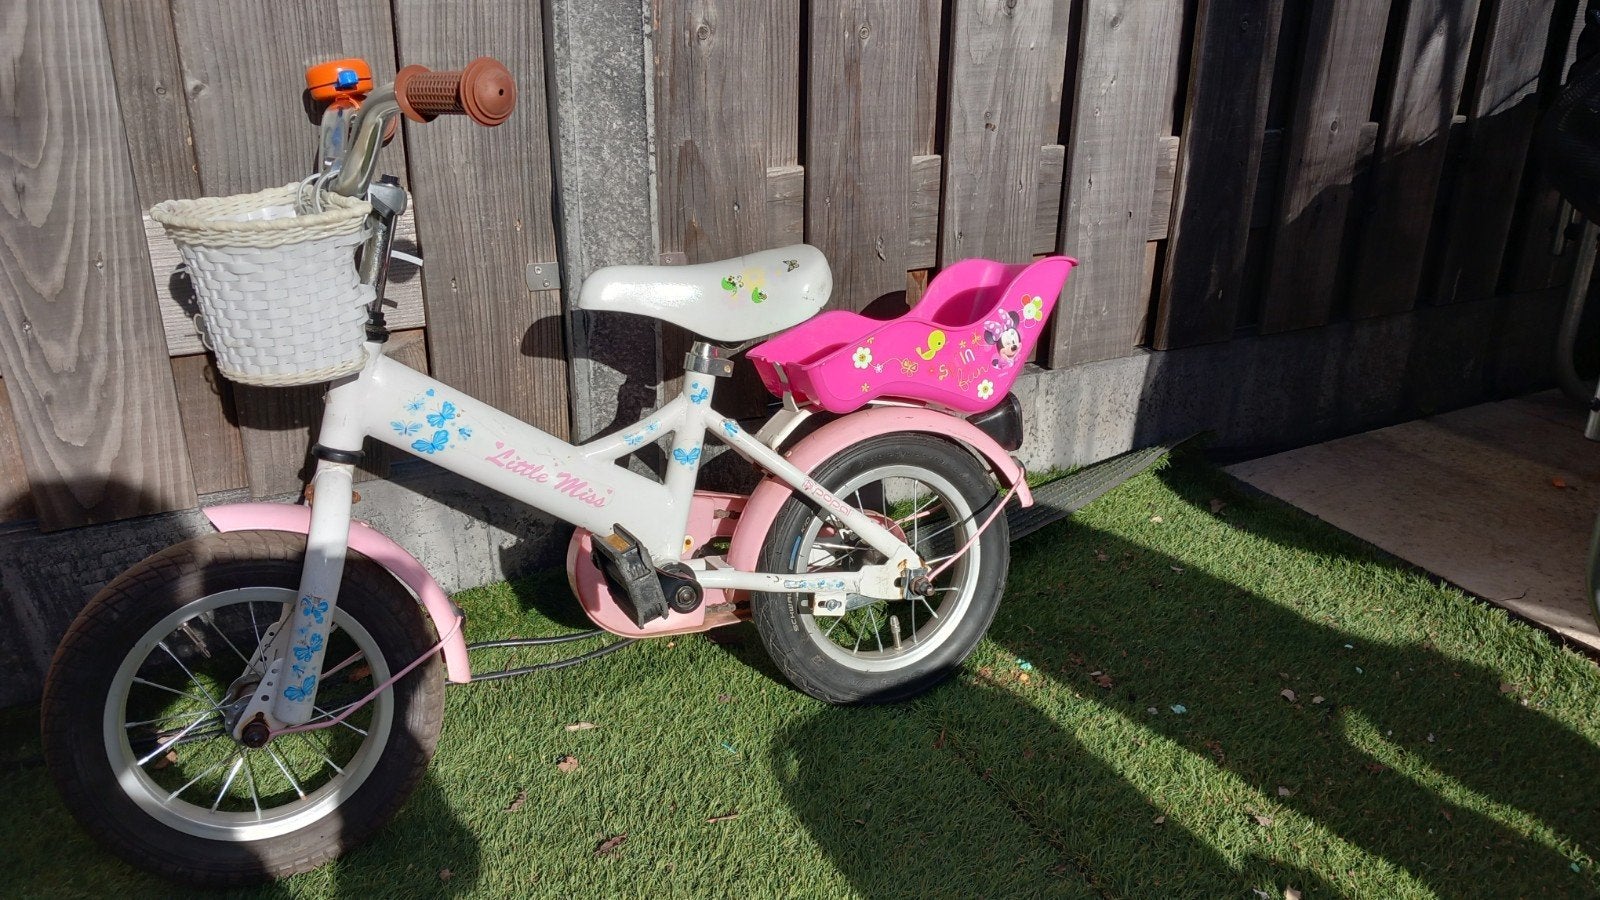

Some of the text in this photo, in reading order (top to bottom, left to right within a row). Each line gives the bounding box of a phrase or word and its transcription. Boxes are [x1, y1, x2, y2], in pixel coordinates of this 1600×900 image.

[484, 448, 606, 508] Little Miss
[786, 592, 800, 632] SCHWAL
